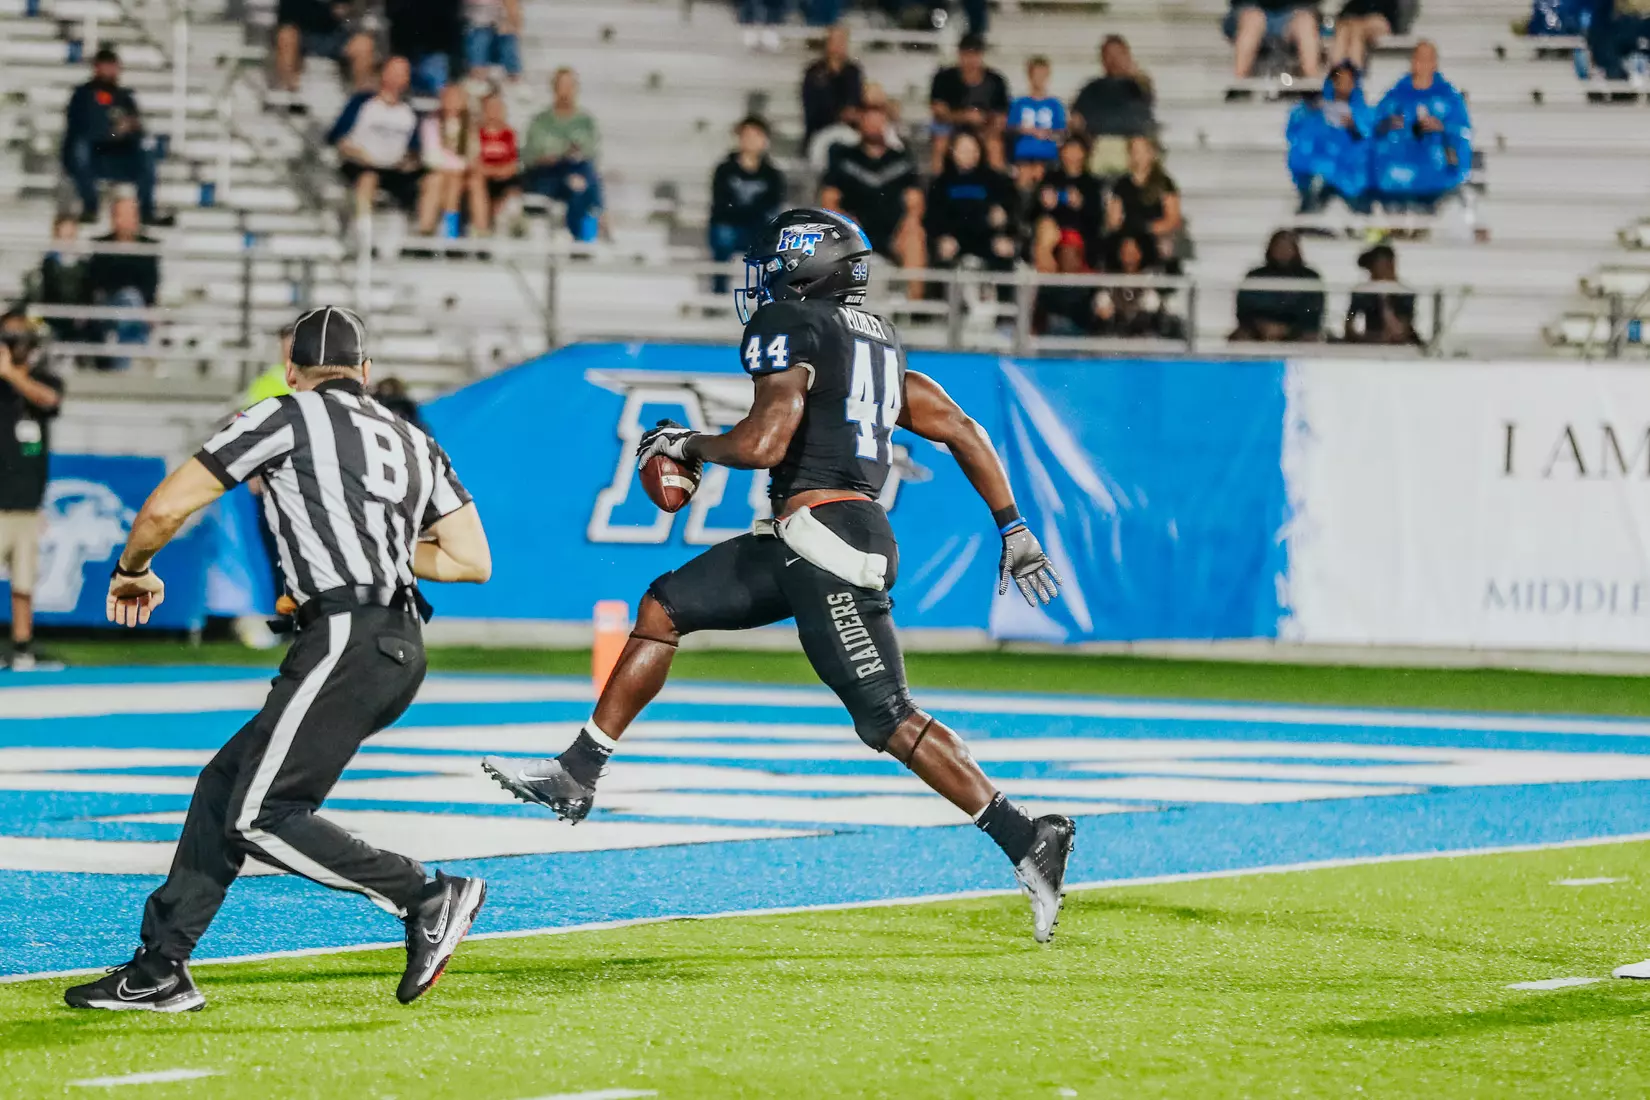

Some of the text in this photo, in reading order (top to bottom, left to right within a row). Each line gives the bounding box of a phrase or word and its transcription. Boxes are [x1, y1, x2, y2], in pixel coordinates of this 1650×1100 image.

[775, 224, 825, 257] MT
[852, 263, 868, 281] 44
[745, 334, 788, 370] 44
[846, 339, 902, 466] 44
[350, 411, 408, 504] B
[1499, 419, 1650, 480] I AM
[827, 592, 885, 678] RAIDERS
